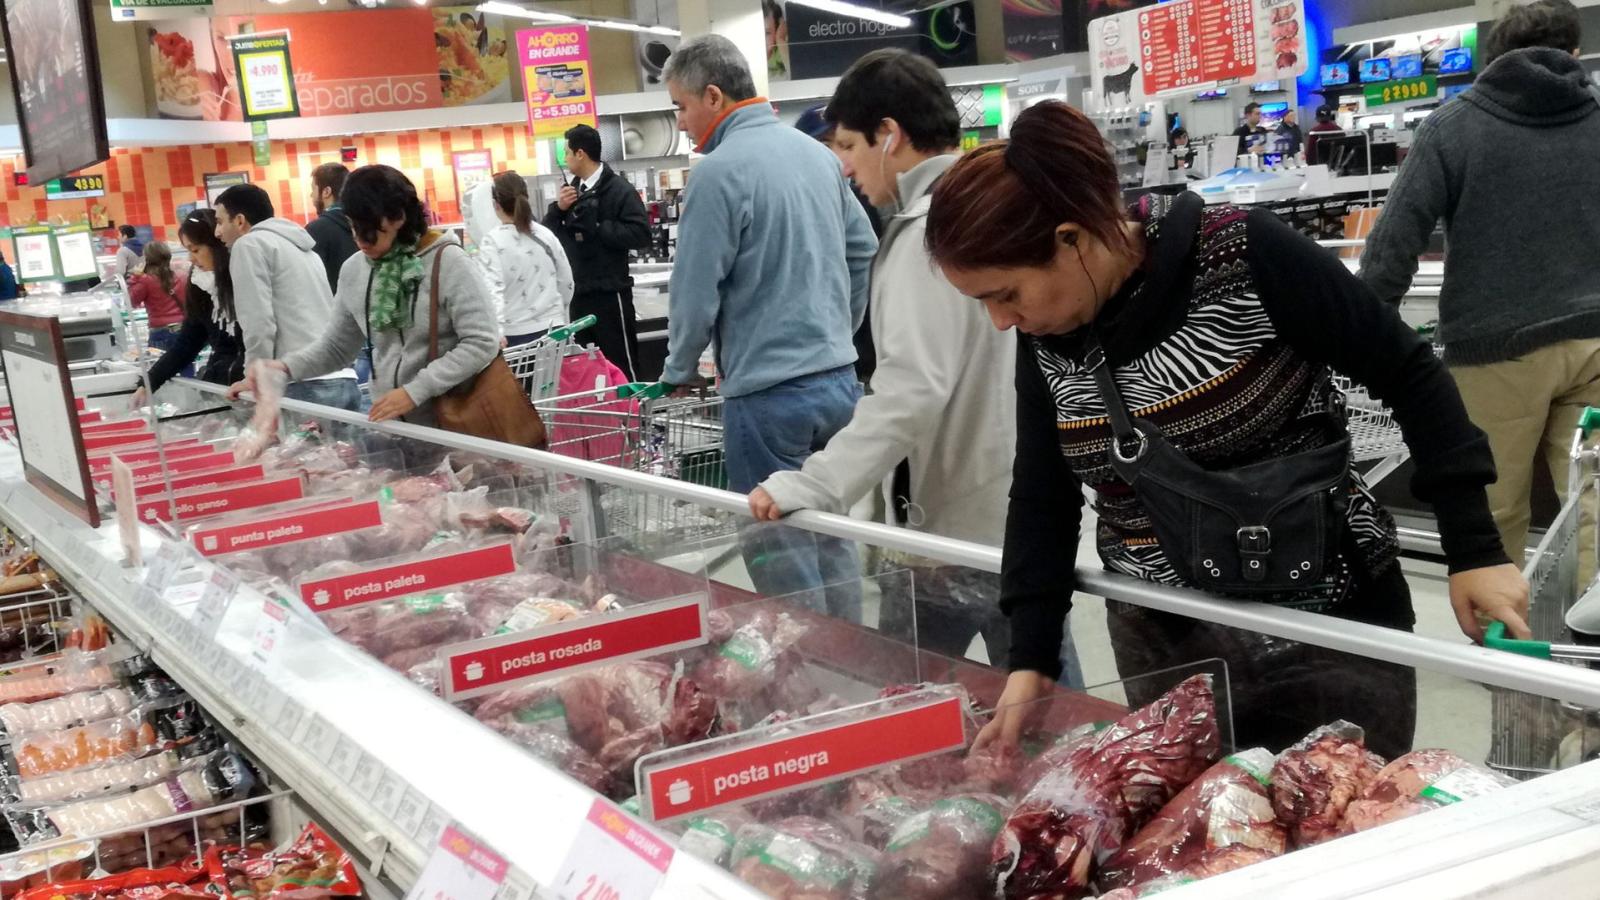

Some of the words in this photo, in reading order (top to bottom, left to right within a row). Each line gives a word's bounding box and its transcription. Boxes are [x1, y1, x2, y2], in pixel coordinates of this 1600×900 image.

[808, 20, 856, 37] electro
[528, 32, 579, 47] AHORRO
[528, 50, 541, 59] EN
[542, 45, 579, 58] GRANDE
[299, 77, 427, 116] eparados
[1017, 84, 1046, 95] SONY
[196, 498, 228, 512] ganso
[230, 530, 265, 546] punta
[267, 524, 304, 540] paleta
[344, 582, 382, 600] posta
[384, 573, 426, 592] paleta
[501, 648, 546, 674] posta
[549, 638, 602, 661] rosada
[713, 764, 769, 795] posta
[773, 749, 829, 777] negra
